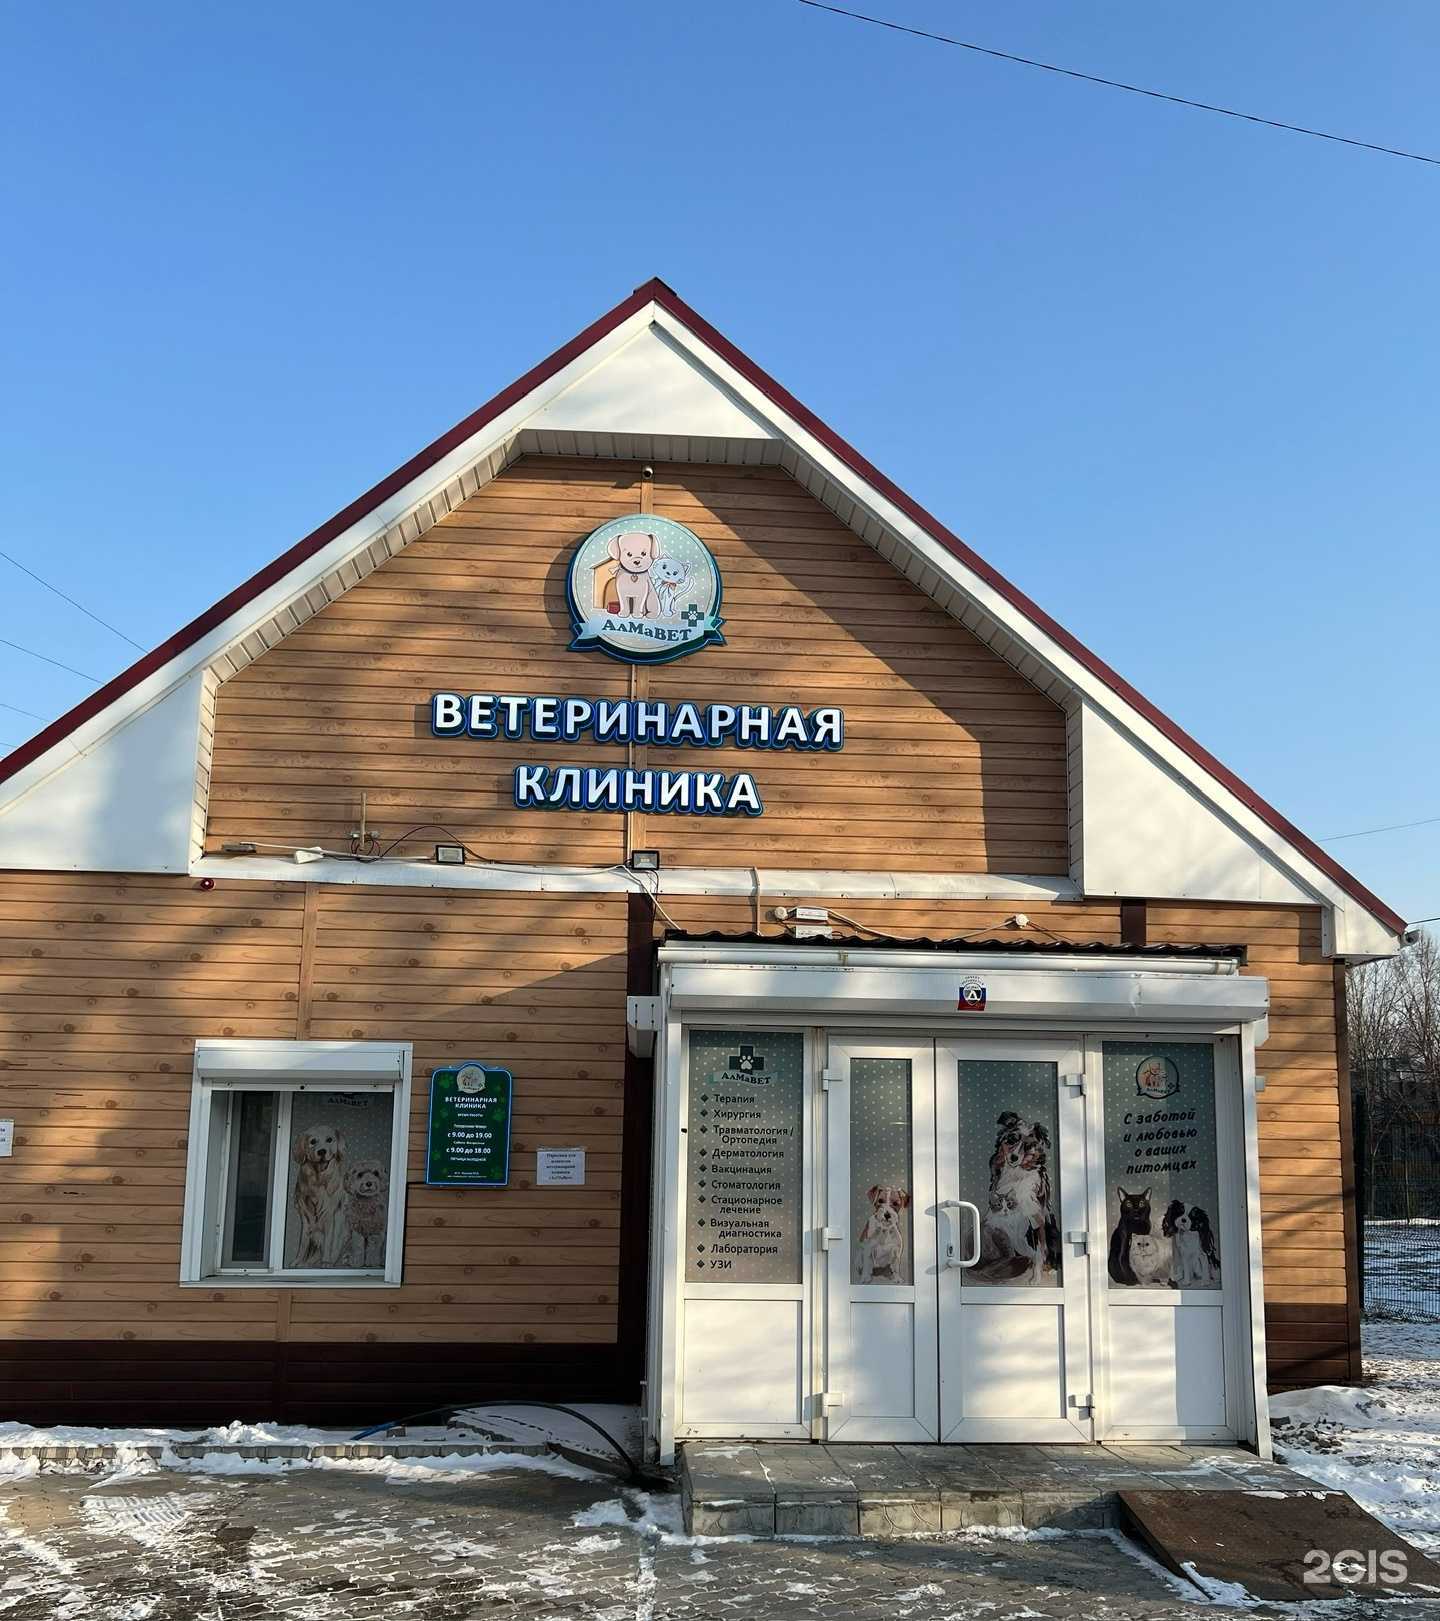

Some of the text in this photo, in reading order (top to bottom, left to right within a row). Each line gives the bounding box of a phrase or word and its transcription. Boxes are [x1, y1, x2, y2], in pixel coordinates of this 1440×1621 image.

[433, 693, 844, 748] ВЕТЕРИНАРНАЯ
[516, 765, 761, 812] КЛИНИКА
[713, 1093, 755, 1105] Терапия
[713, 1109, 762, 1120] Хирургия
[1136, 1108, 1197, 1124] заботой
[713, 1125, 788, 1136] Травматология
[1136, 1128, 1198, 1142] любовью
[722, 1135, 778, 1146] Ортопедия
[711, 1148, 785, 1160] Дерматология
[1145, 1144, 1188, 1157] ваших
[711, 1164, 772, 1175] Вакцинация
[1126, 1159, 1198, 1175] питомцах
[711, 1179, 781, 1190] Стоматология
[711, 1195, 783, 1206] Стационарное
[719, 1206, 761, 1214] лечение
[710, 1218, 770, 1229] Визуальная
[718, 1230, 782, 1239] диагностика
[710, 1244, 778, 1256] Лаборатория
[710, 1260, 732, 1269] УЗИ
